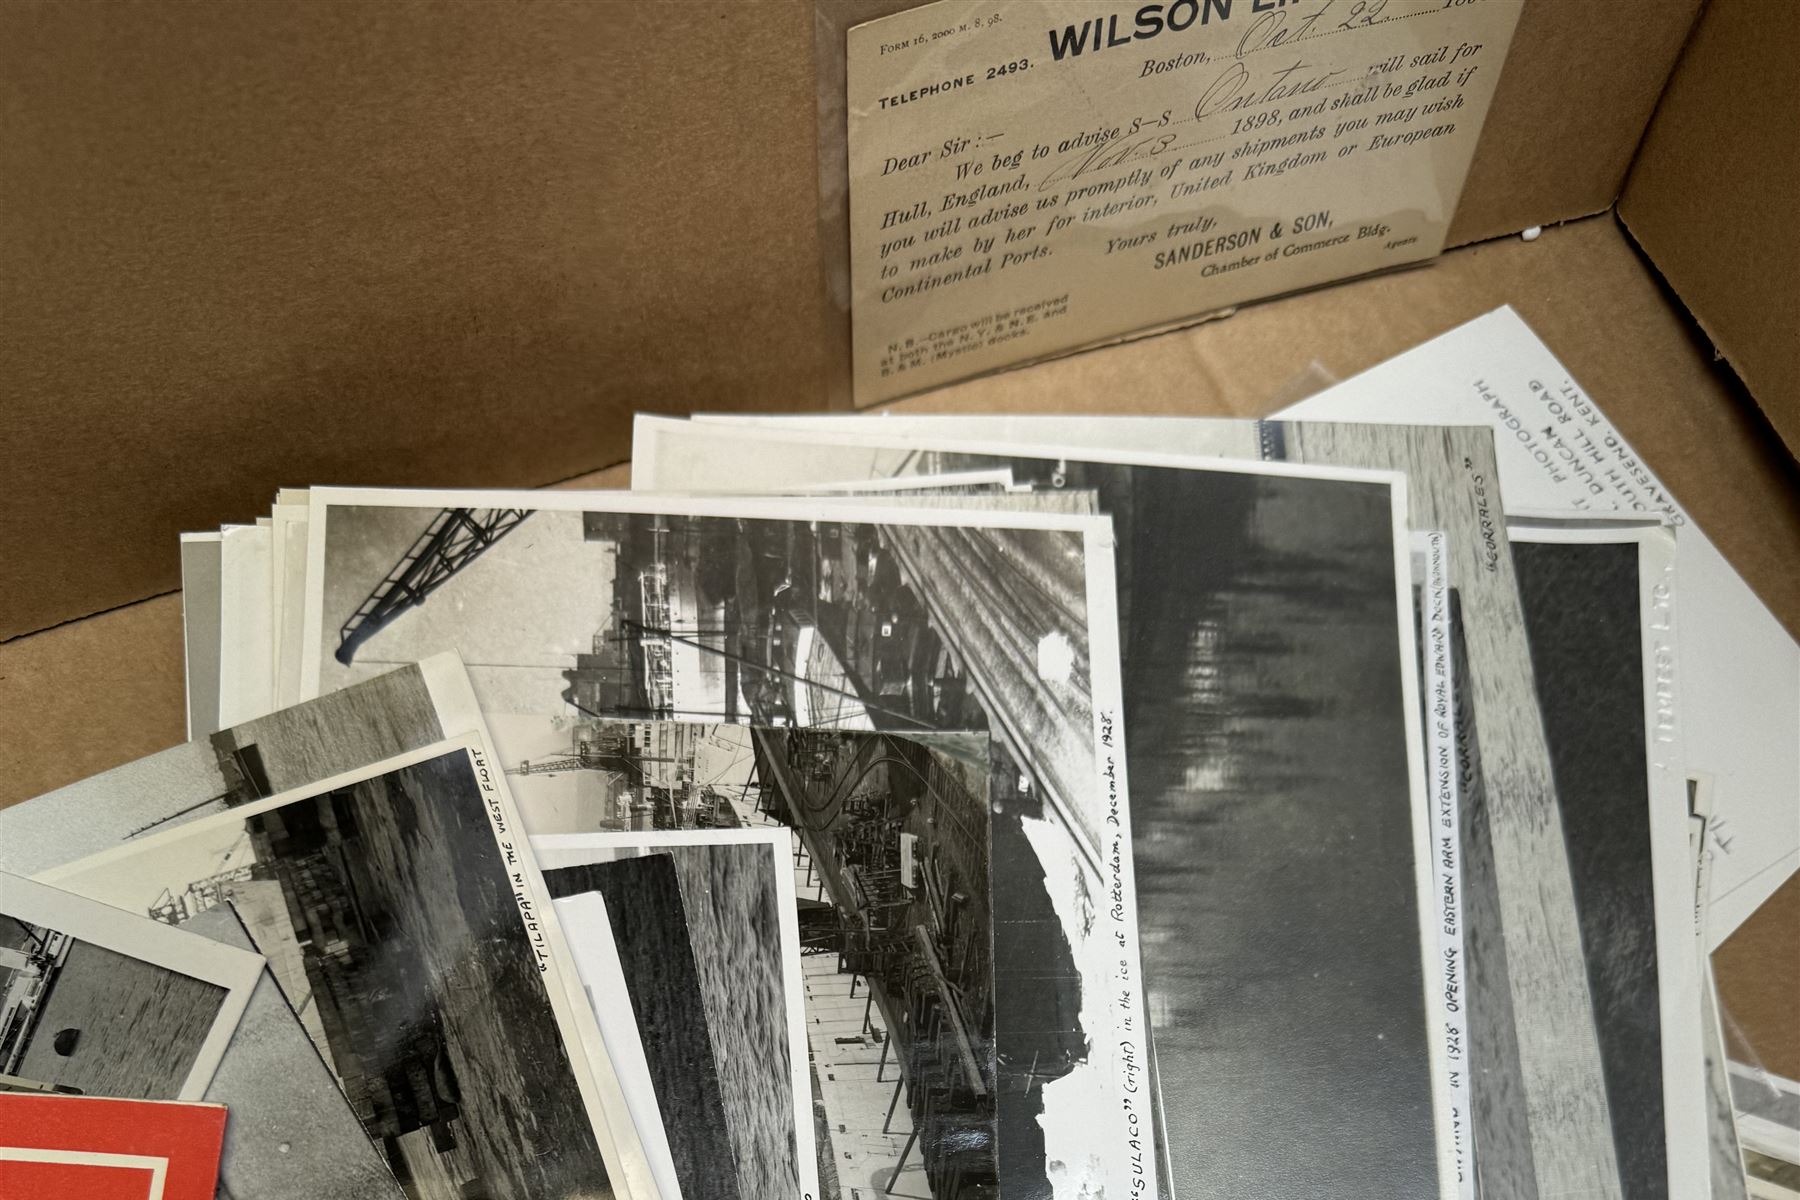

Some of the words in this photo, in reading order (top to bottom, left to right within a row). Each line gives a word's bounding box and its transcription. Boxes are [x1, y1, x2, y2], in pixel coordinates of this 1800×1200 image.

[913, 34, 929, 47] 16,
[931, 28, 956, 40] 2000
[1048, 0, 1232, 61] WILSON
[878, 74, 975, 110] TELEPHONE
[986, 58, 1034, 81] 2493.
[1138, 51, 1211, 79] Boston,
[955, 161, 983, 181] We
[992, 149, 1024, 170] beg
[1031, 143, 1050, 160] to
[1058, 127, 1120, 154] advise
[1368, 55, 1404, 76] will
[1409, 46, 1449, 69] sail
[1449, 42, 1483, 65] for
[880, 201, 932, 230] Hull,
[938, 173, 1030, 213] England,
[1231, 109, 1283, 136] 1898,
[1289, 97, 1328, 121] and
[1330, 86, 1379, 111] shall
[1382, 82, 1402, 99] be
[1402, 71, 1451, 99] glad
[1456, 66, 1479, 89] if
[880, 151, 932, 177] Dear
[880, 236, 916, 259] you
[924, 217, 961, 242] will
[968, 201, 1029, 230] advise
[1036, 194, 1059, 210] us
[1064, 168, 1154, 207] promptly
[1160, 159, 1183, 179] of
[1189, 151, 1226, 170] any
[1231, 126, 1327, 160] shipments
[1333, 116, 1369, 138] you
[1375, 105, 1418, 127] may
[1421, 94, 1465, 116] wish
[880, 264, 899, 281] to
[909, 246, 963, 271] make
[973, 236, 996, 254] by
[1004, 224, 1037, 245] her
[1045, 214, 1076, 236] for
[1082, 192, 1158, 223] interior,
[1170, 170, 1233, 200] United
[1242, 150, 1328, 182] Kingdom
[1337, 143, 1359, 158] or
[1366, 123, 1456, 152] European
[1106, 231, 1157, 255] Yours
[1167, 215, 1218, 239] truly,
[1154, 227, 1261, 270] SANDERSON
[1269, 222, 1283, 240] &
[1293, 210, 1334, 236] SON,
[1200, 255, 1261, 278] Chamber
[1264, 247, 1279, 262] of
[1282, 234, 1350, 258] Commerce
[1357, 223, 1391, 241] Bldg.
[882, 259, 992, 304] Continental
[1000, 245, 1053, 269] Ports.
[1528, 379, 1572, 425] ROAD
[1560, 380, 1600, 427] KENT.
[1473, 379, 1568, 484] PHOTOGRAPH
[1573, 428, 1604, 465] HILL
[1540, 425, 1604, 496] DUNCAN
[1432, 626, 1446, 678] EDWARD
[1434, 677, 1448, 719] ROYAL
[1100, 710, 1114, 748] 1928.
[1437, 718, 1449, 740] OF
[471, 748, 495, 792] FLOAT
[1102, 756, 1120, 828] December
[1438, 746, 1454, 830] EXTENSION
[488, 799, 507, 834] WEST
[502, 841, 518, 866] THE
[1442, 837, 1454, 870] ARM
[512, 872, 525, 889] IN
[1109, 833, 1123, 922] Rotterdam,
[1443, 873, 1458, 937] EASTERN
[1113, 934, 1125, 948] at
[1115, 959, 1129, 981] ice
[1445, 947, 1460, 1014] OPENING
[1116, 1016, 1133, 1032] in
[1118, 990, 1130, 1011] the
[1119, 1041, 1141, 1094] (right)
